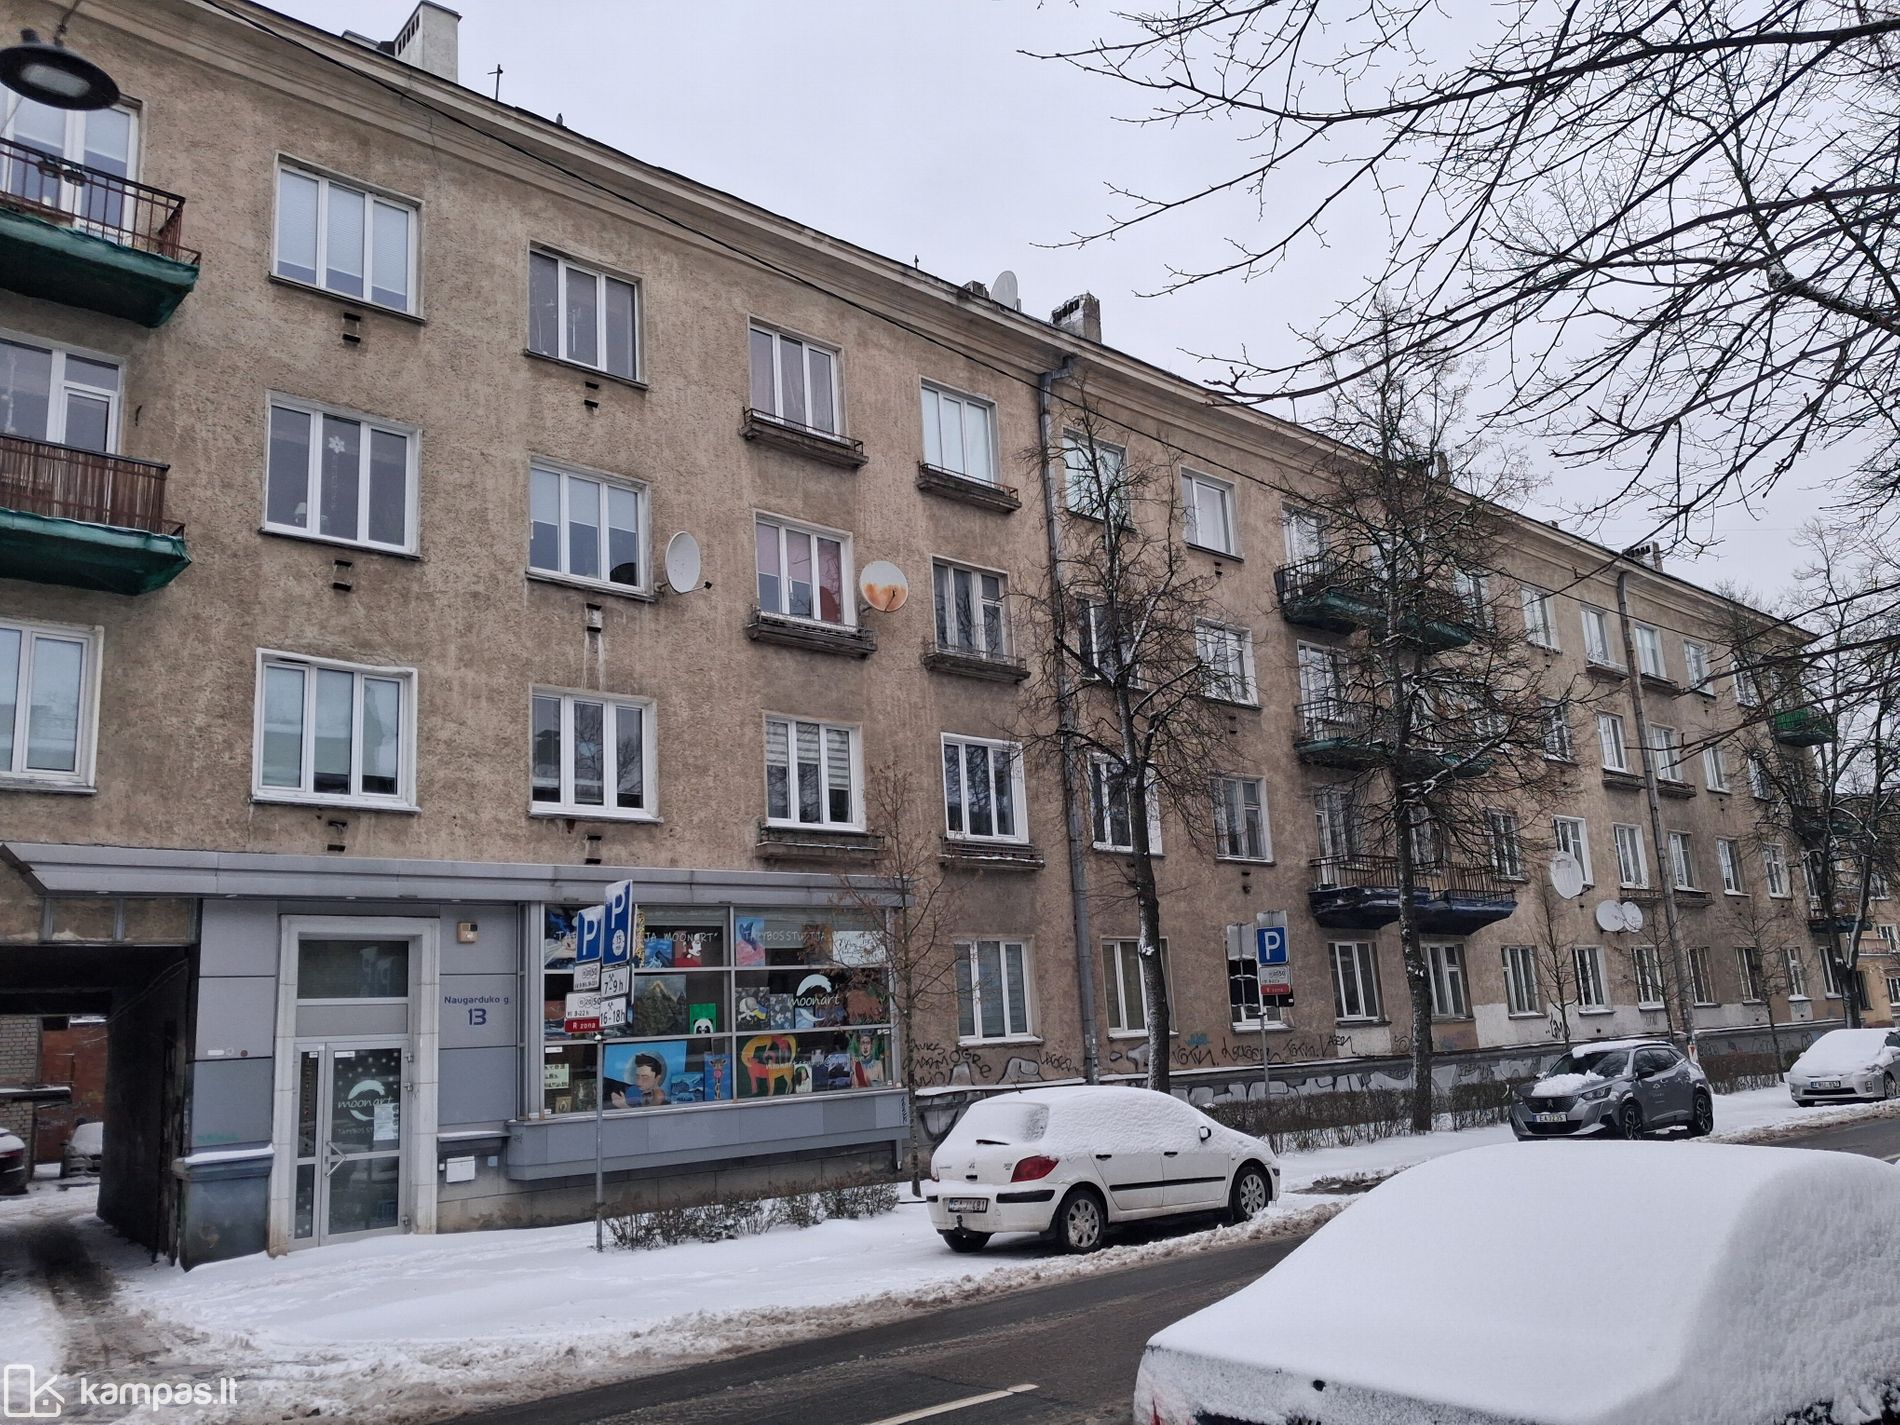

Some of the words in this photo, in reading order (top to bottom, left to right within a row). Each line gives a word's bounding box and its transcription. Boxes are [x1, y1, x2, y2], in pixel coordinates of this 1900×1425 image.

[611, 891, 626, 929] P
[583, 917, 598, 956] P
[1264, 931, 1281, 960] P
[444, 995, 500, 1006] Naugarduko
[468, 1008, 487, 1026] 13
[572, 1022, 578, 1030] R
[580, 1022, 596, 1030] zona
